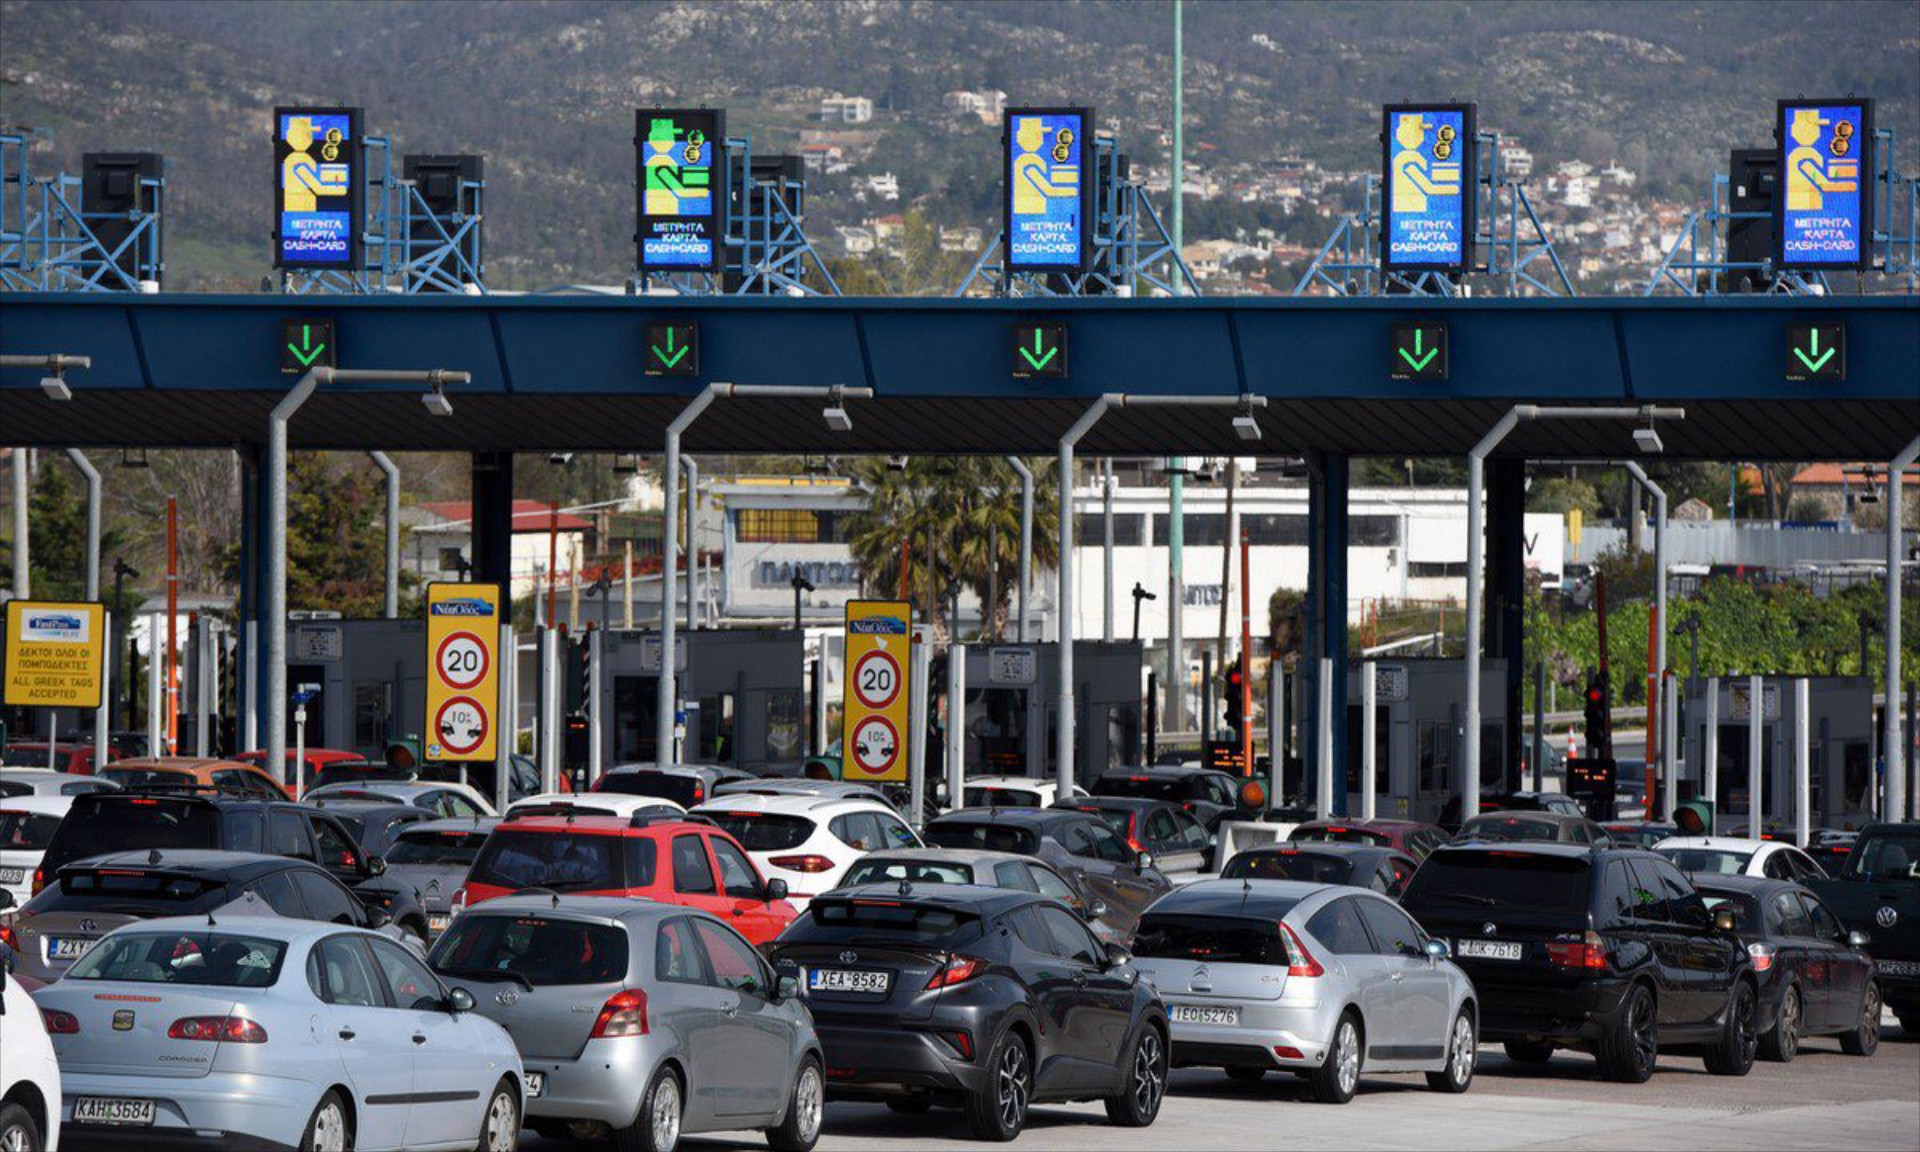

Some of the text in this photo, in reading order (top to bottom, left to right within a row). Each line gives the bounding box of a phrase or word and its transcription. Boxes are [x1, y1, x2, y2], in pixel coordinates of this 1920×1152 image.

[448, 650, 478, 672] 20
[13, 676, 93, 688] ALL GREEK TAGS
[863, 668, 891, 691] 20
[29, 689, 77, 699] ACCEPTED
